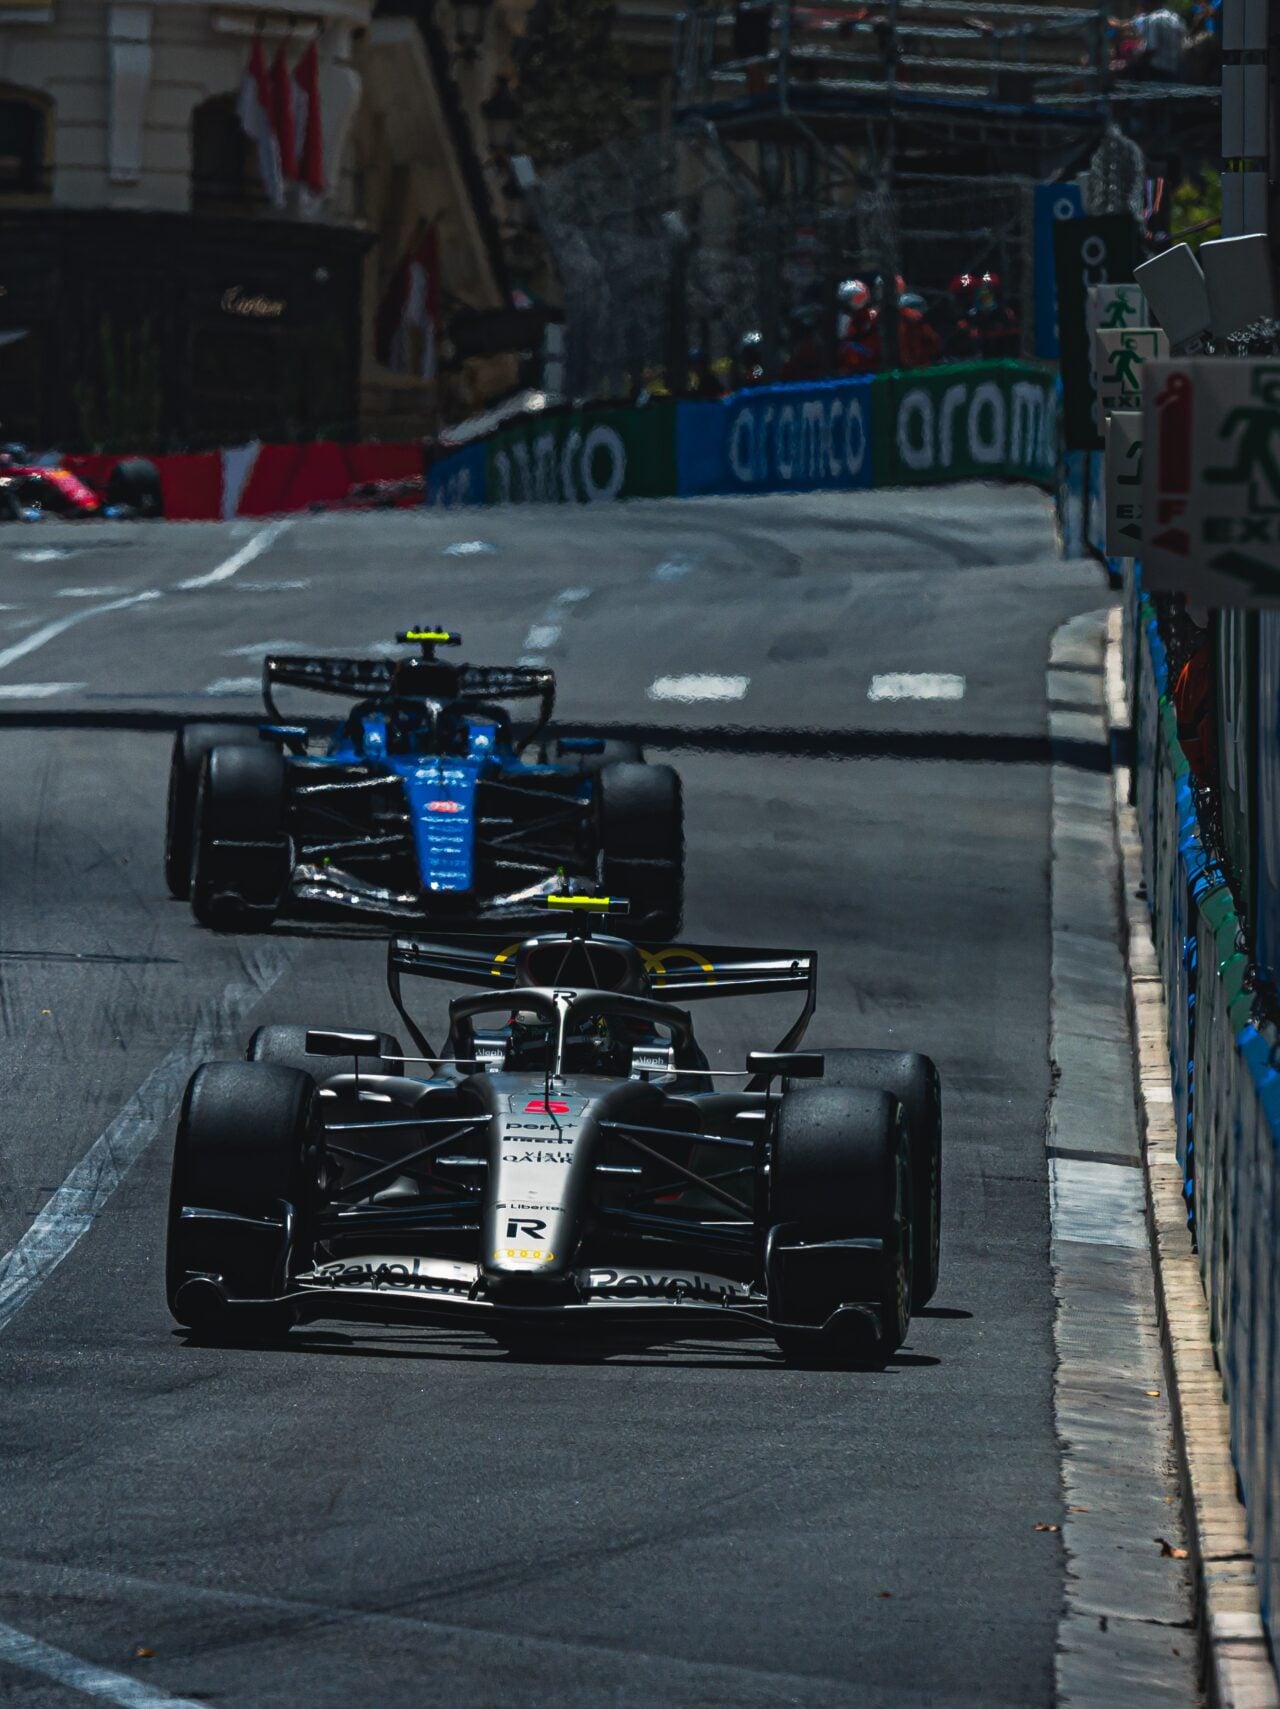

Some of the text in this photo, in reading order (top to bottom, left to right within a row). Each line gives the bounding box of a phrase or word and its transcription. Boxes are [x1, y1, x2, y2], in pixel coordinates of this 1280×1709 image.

[1102, 395, 1141, 408] EXI
[729, 398, 867, 483] aramco
[1202, 516, 1280, 543] EX
[523, 1099, 570, 1114] 5
